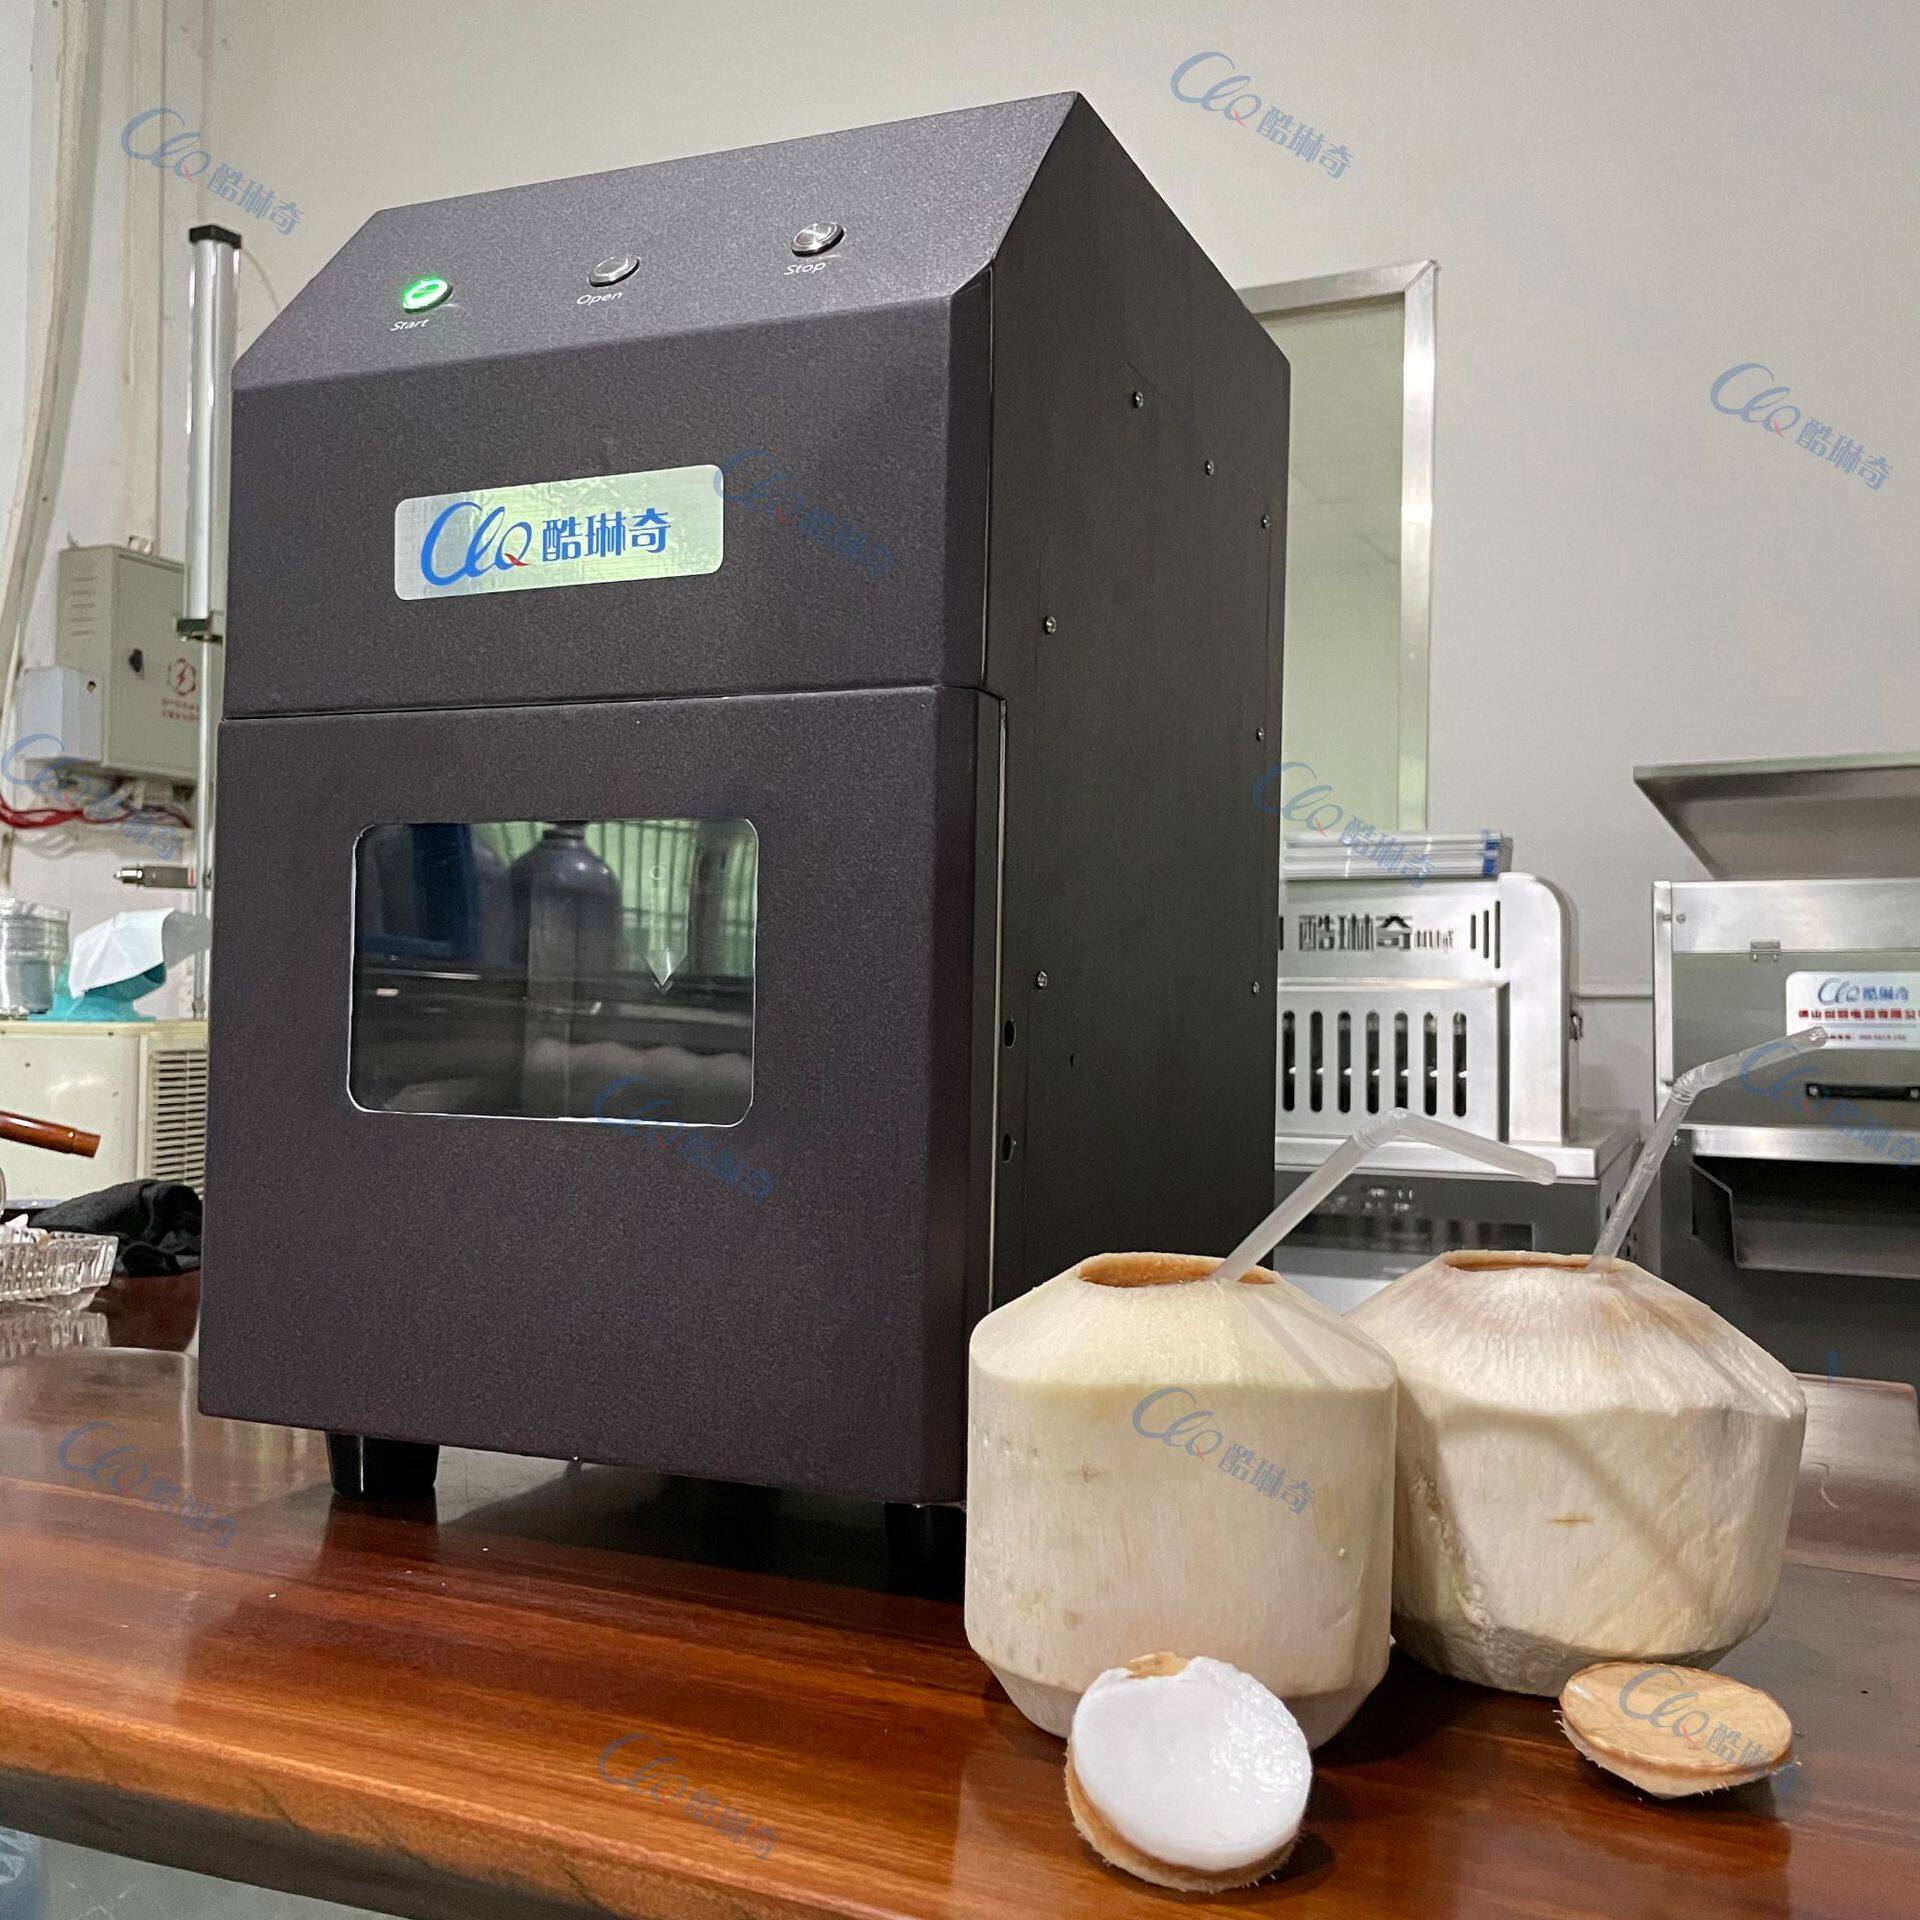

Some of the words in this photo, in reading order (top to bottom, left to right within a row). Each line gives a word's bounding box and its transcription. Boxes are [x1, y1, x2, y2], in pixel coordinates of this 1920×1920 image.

[784, 262, 826, 275] Stop
[577, 292, 623, 305] Open
[390, 319, 430, 331] Start
[542, 507, 671, 562] 酷琳奇
